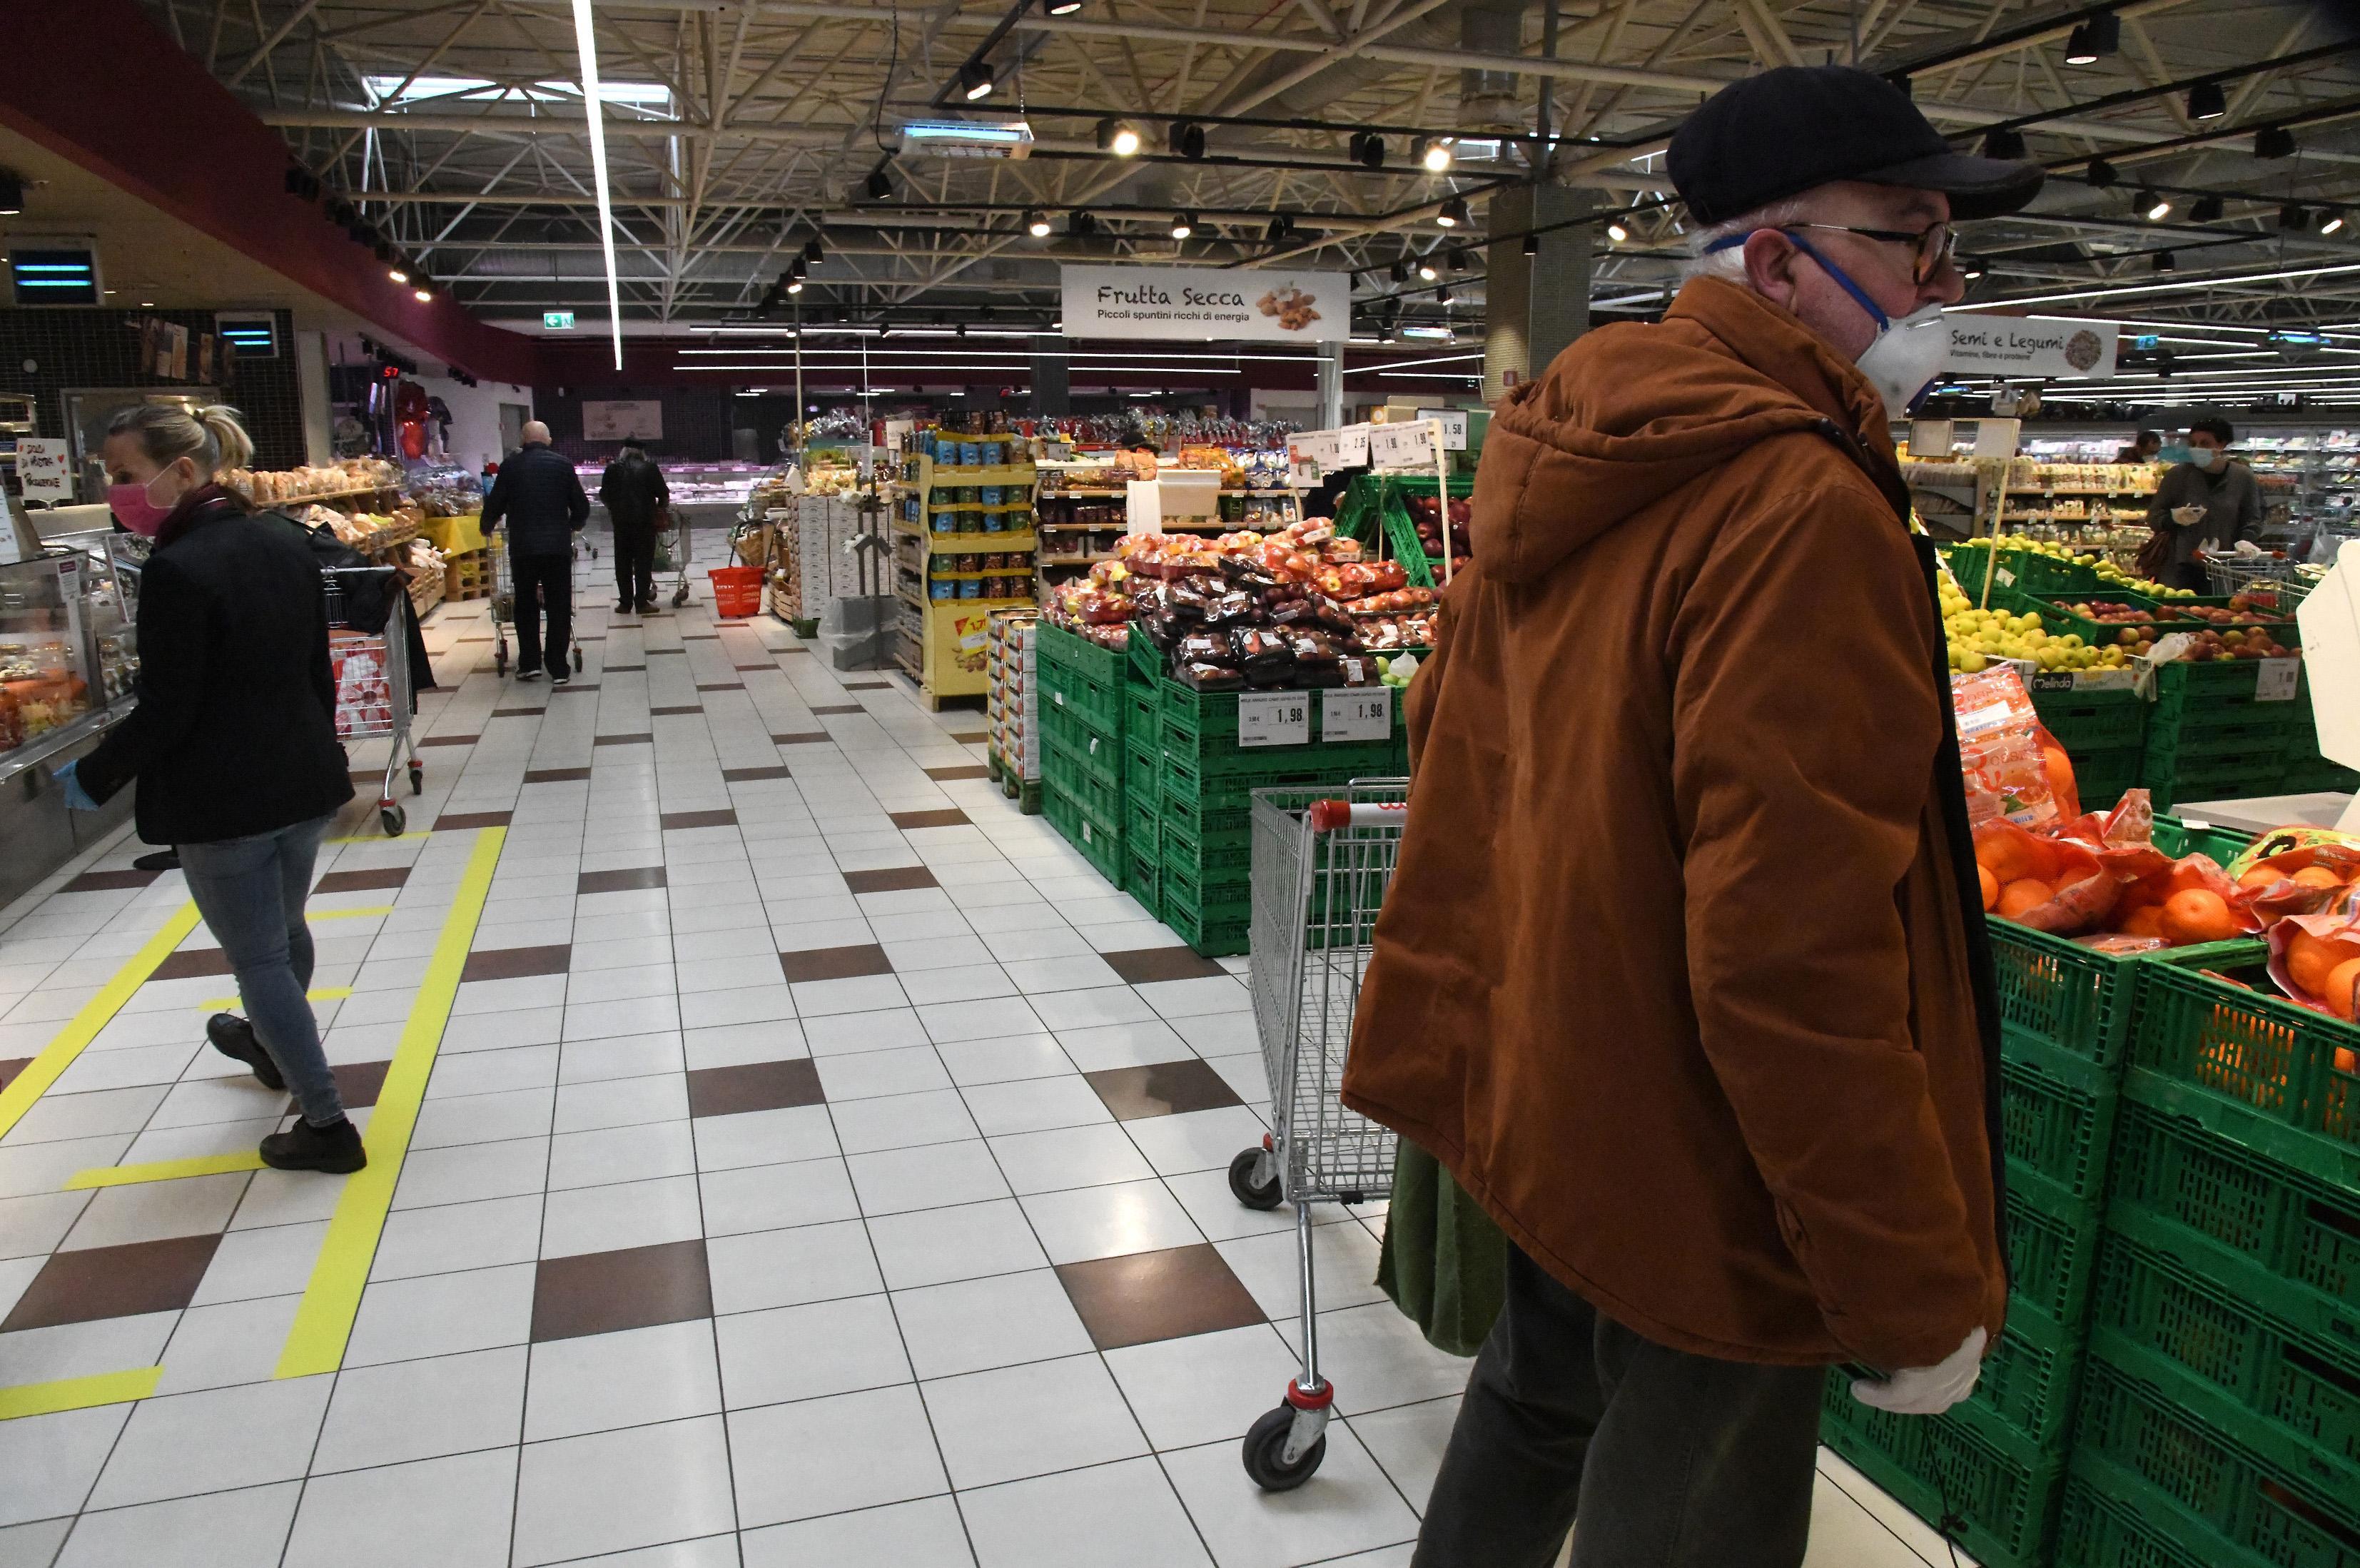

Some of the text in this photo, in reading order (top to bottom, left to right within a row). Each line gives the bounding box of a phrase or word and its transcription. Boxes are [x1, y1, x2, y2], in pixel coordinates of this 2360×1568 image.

[1098, 285, 1245, 306] Frutta Secca
[1098, 309, 1250, 323] Piccoli spuntini ricchi di energia
[1951, 330, 2064, 355] Semi e Legumi
[384, 366, 399, 378] 57
[2032, 677, 2072, 689] Melinda
[1277, 707, 1303, 724] 1,98
[1359, 703, 1383, 719] 1,98
